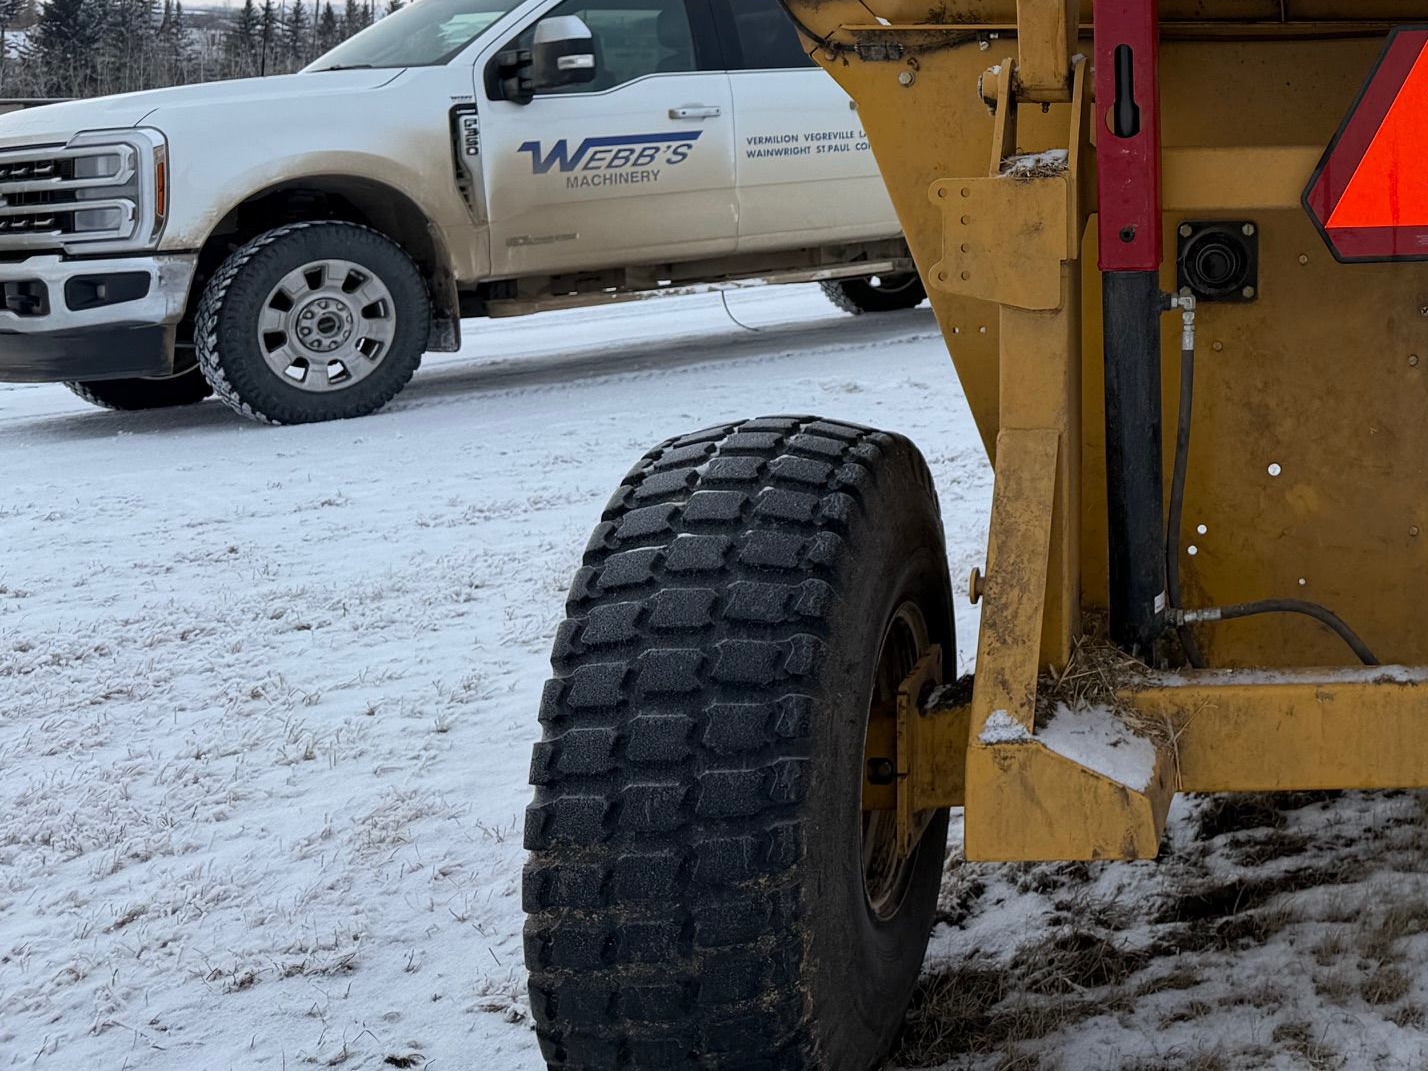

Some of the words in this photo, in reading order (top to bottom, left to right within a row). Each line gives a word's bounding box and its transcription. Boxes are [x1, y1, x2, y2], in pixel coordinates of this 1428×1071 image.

[746, 134, 799, 145] VERMILION
[803, 130, 854, 142] VEGREVILLE
[517, 130, 704, 175] WEBB'S
[746, 145, 812, 158] WAINWRIGHT
[566, 169, 661, 189] MACHINERY
